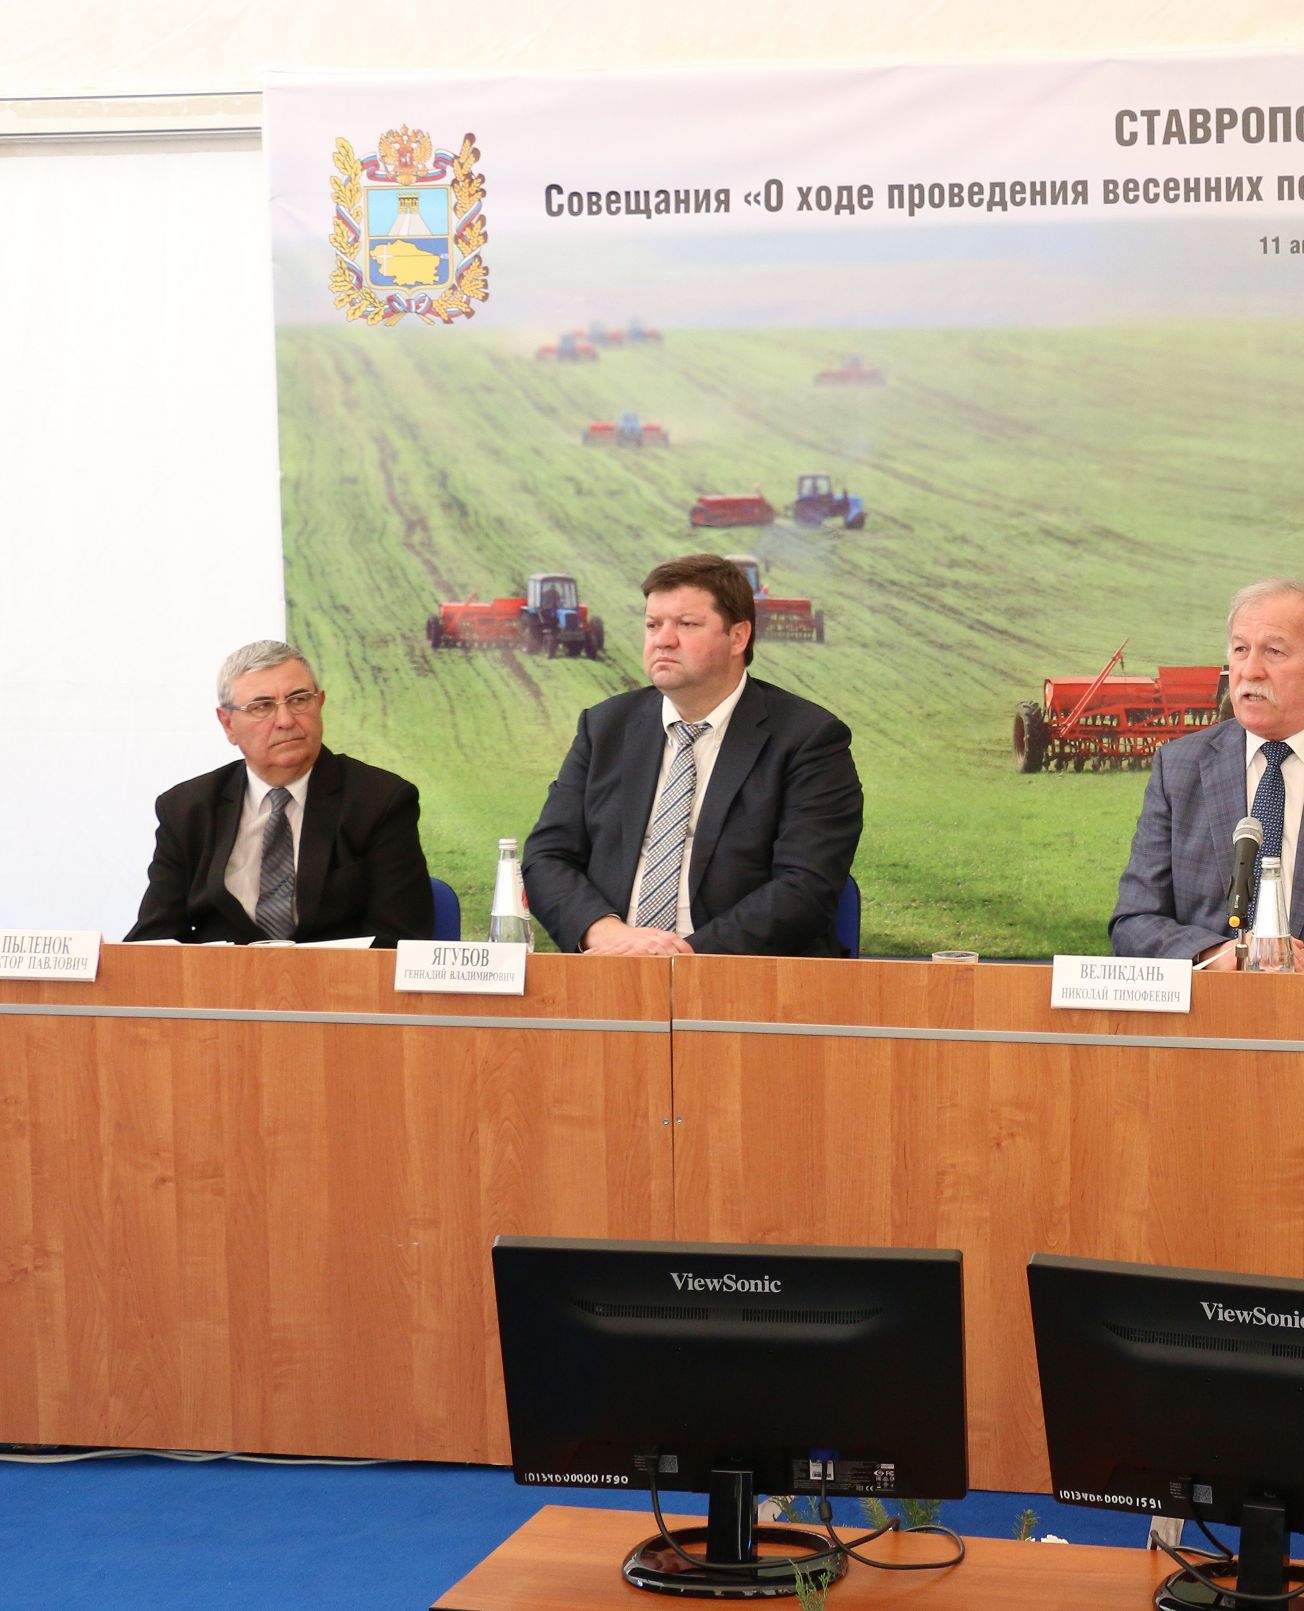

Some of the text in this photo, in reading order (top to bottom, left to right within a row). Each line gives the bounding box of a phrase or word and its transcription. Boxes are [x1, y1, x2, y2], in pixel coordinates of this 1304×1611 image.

[545, 181, 732, 220] Совещания
[743, 177, 784, 214] «О
[796, 184, 875, 217] ходе
[887, 179, 1090, 217] проведения
[1102, 175, 1264, 208] весенних
[1259, 235, 1280, 255] 11
[2, 935, 73, 955] ПЫЛЕНОК
[0, 955, 88, 971] ТОР ПАВЛОВИЧ
[432, 947, 490, 967] ЯГУБОВ
[404, 968, 515, 982] ГЕННАДИЙ ВЛАДИМИРОВИЧ
[1080, 963, 1164, 982] ВЕЛИКДАНЬ
[1062, 986, 1181, 1003] НИКОЛАЙ ТИМОФЕЕВИЧ
[670, 1272, 782, 1294] ViewSonic
